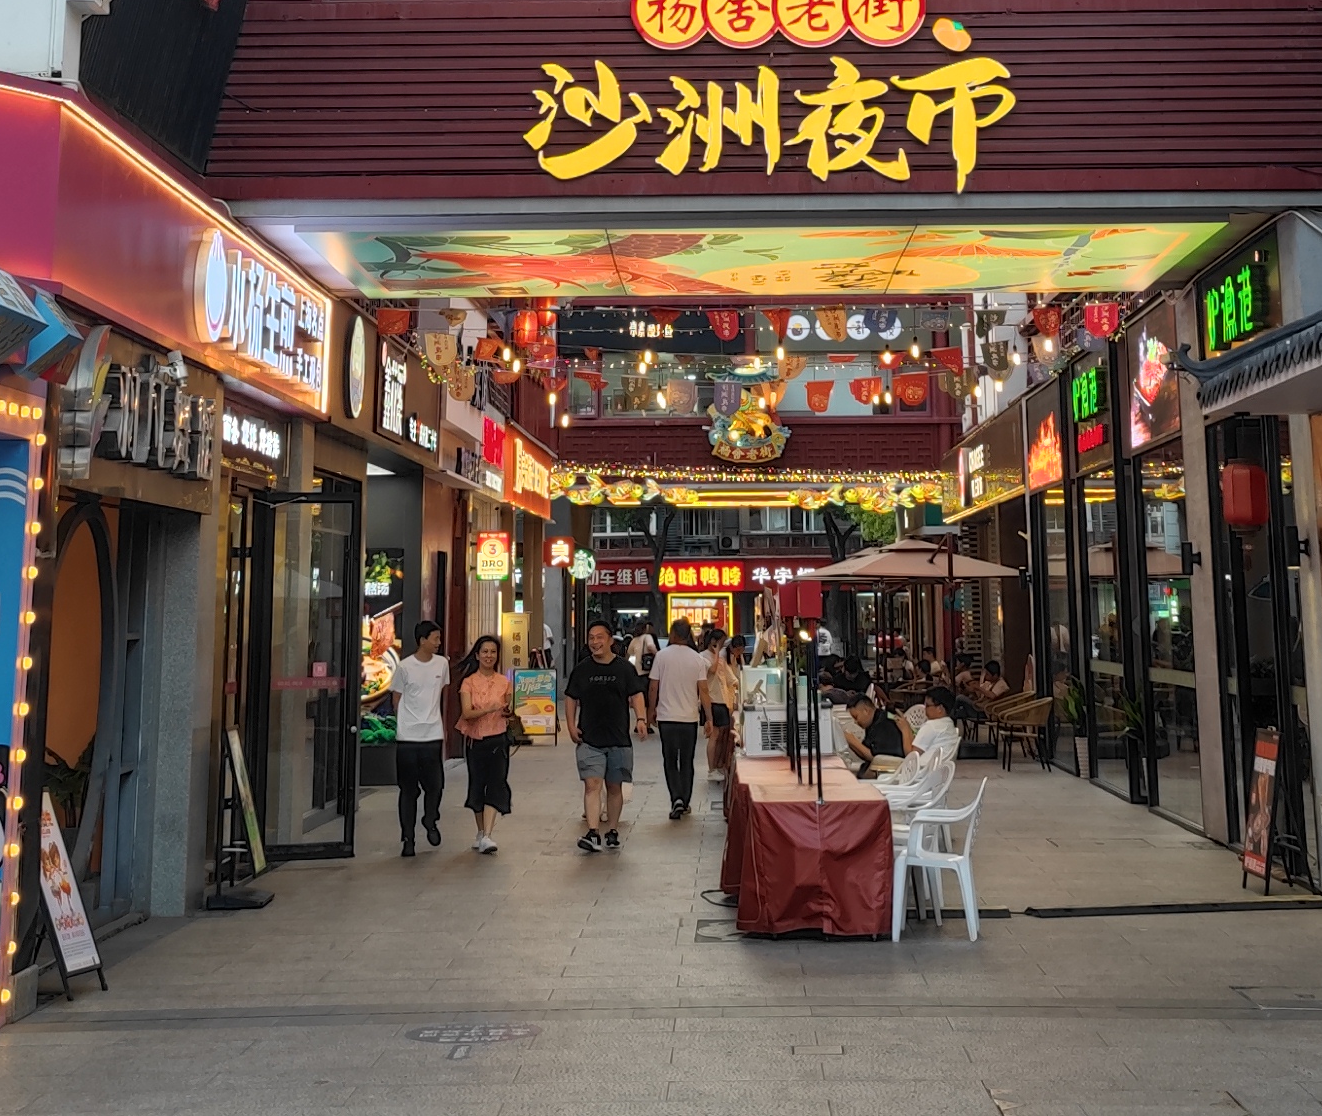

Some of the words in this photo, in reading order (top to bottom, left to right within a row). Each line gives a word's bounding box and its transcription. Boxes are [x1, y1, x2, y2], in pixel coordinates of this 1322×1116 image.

[524, 56, 1017, 194] 沙洲夜市
[228, 249, 296, 378] 小杨生煎
[659, 566, 742, 587] 绝味鸭脖
